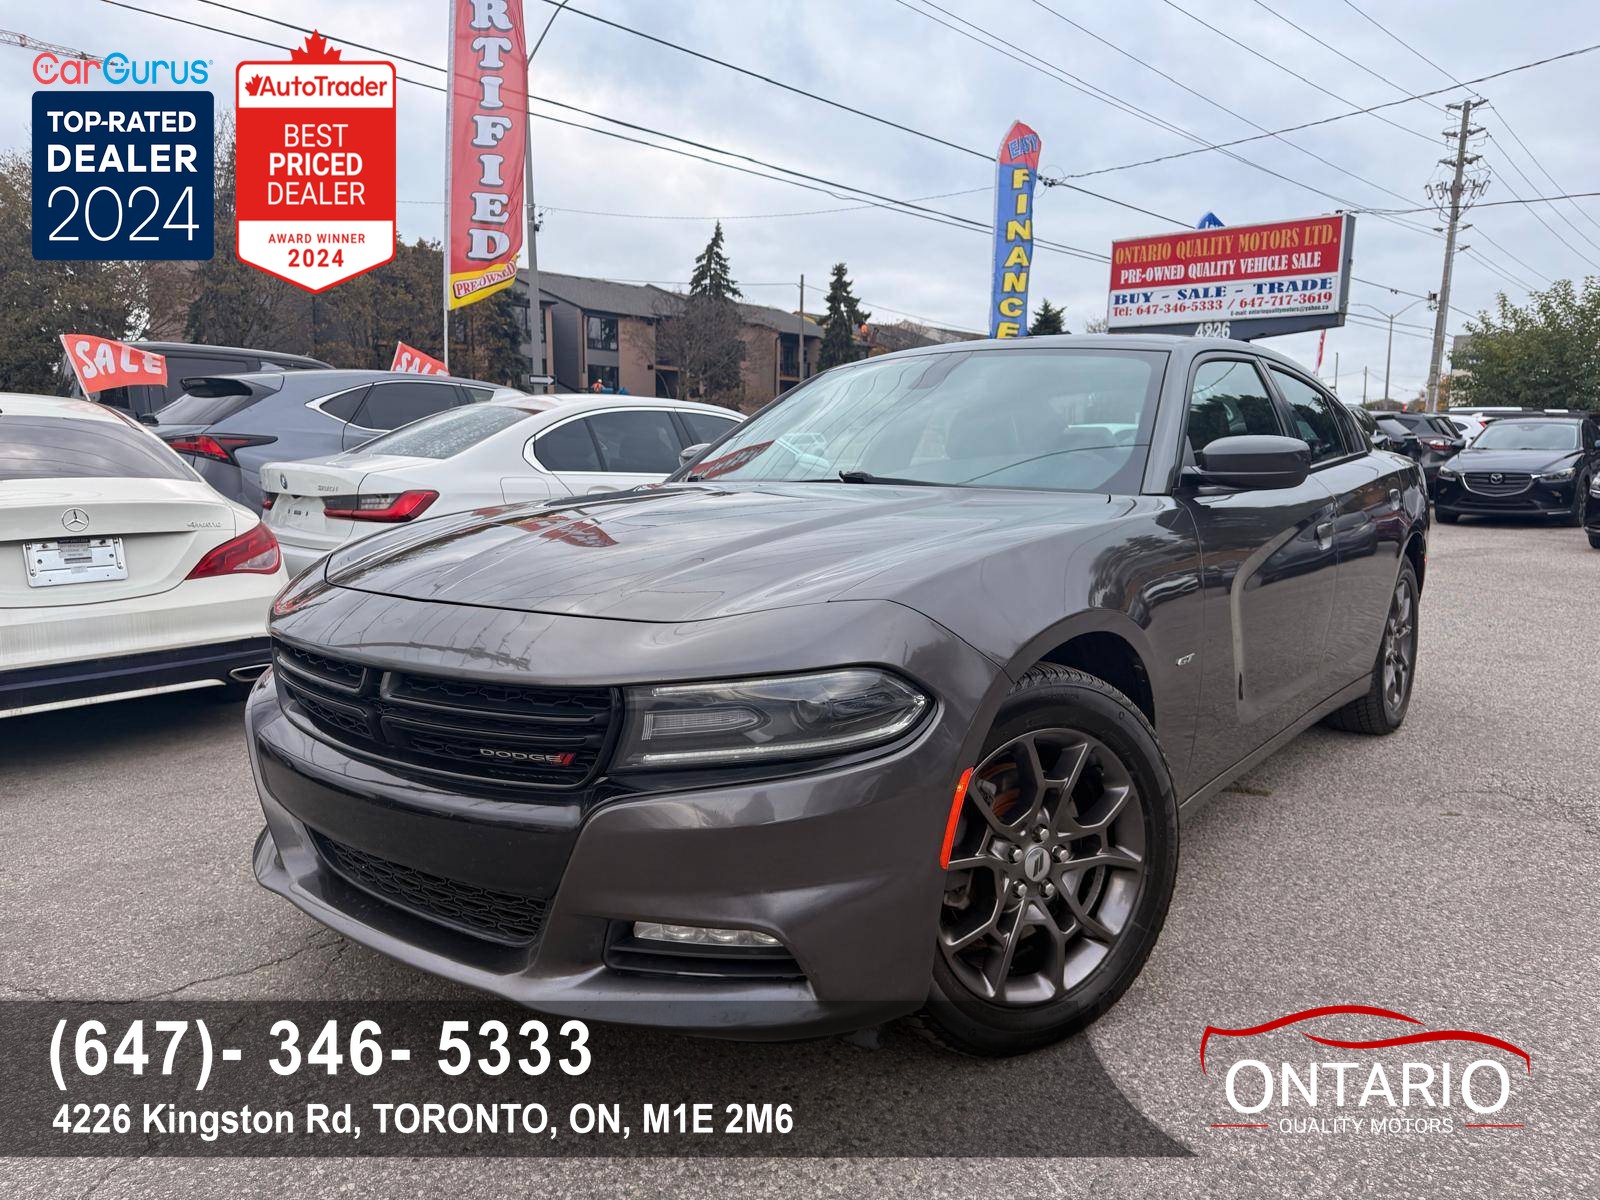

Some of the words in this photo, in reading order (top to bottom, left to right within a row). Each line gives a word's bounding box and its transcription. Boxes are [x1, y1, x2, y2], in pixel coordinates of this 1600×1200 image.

[1008, 133, 1040, 159] EASY
[996, 167, 1031, 338] FINANCE
[1115, 243, 1172, 264] ONTARIO
[1176, 235, 1234, 260] QUALITY
[1239, 227, 1300, 252] MOTORS
[1304, 224, 1338, 246] LTD.
[1120, 265, 1185, 285] PRE-OWNED
[1188, 260, 1236, 278] QUALITY
[1240, 255, 1288, 274] VEHICLE
[1292, 251, 1321, 269] SALE
[1113, 306, 1133, 317] Tel:
[1136, 299, 1223, 316] 647-346-5333
[1240, 291, 1333, 308] 647-717-3619
[1114, 292, 1154, 305] BUY
[1177, 286, 1227, 300] SALE
[1253, 278, 1333, 295] TRADE
[75, 341, 162, 379] SALE
[479, 748, 562, 763] DODGE
